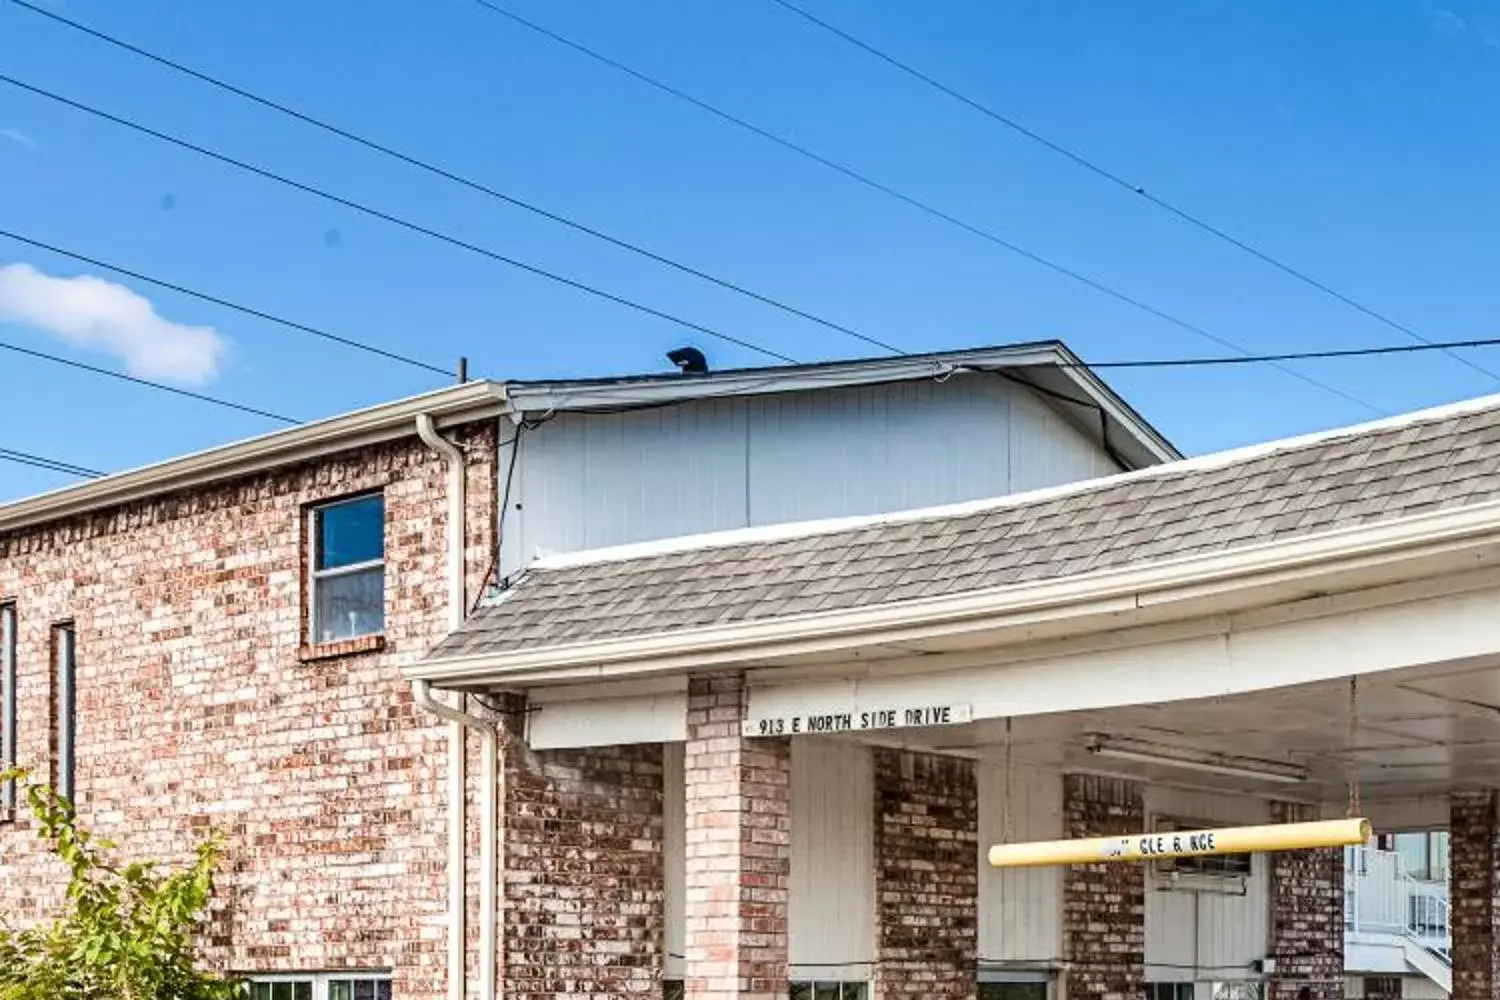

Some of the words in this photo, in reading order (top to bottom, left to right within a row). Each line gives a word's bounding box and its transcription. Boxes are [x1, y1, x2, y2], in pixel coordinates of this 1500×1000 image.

[759, 719, 785, 735] 913
[792, 717, 802, 733] E
[807, 713, 852, 732] NORTH
[861, 709, 897, 729] SIDE
[905, 706, 951, 725] DRIVE
